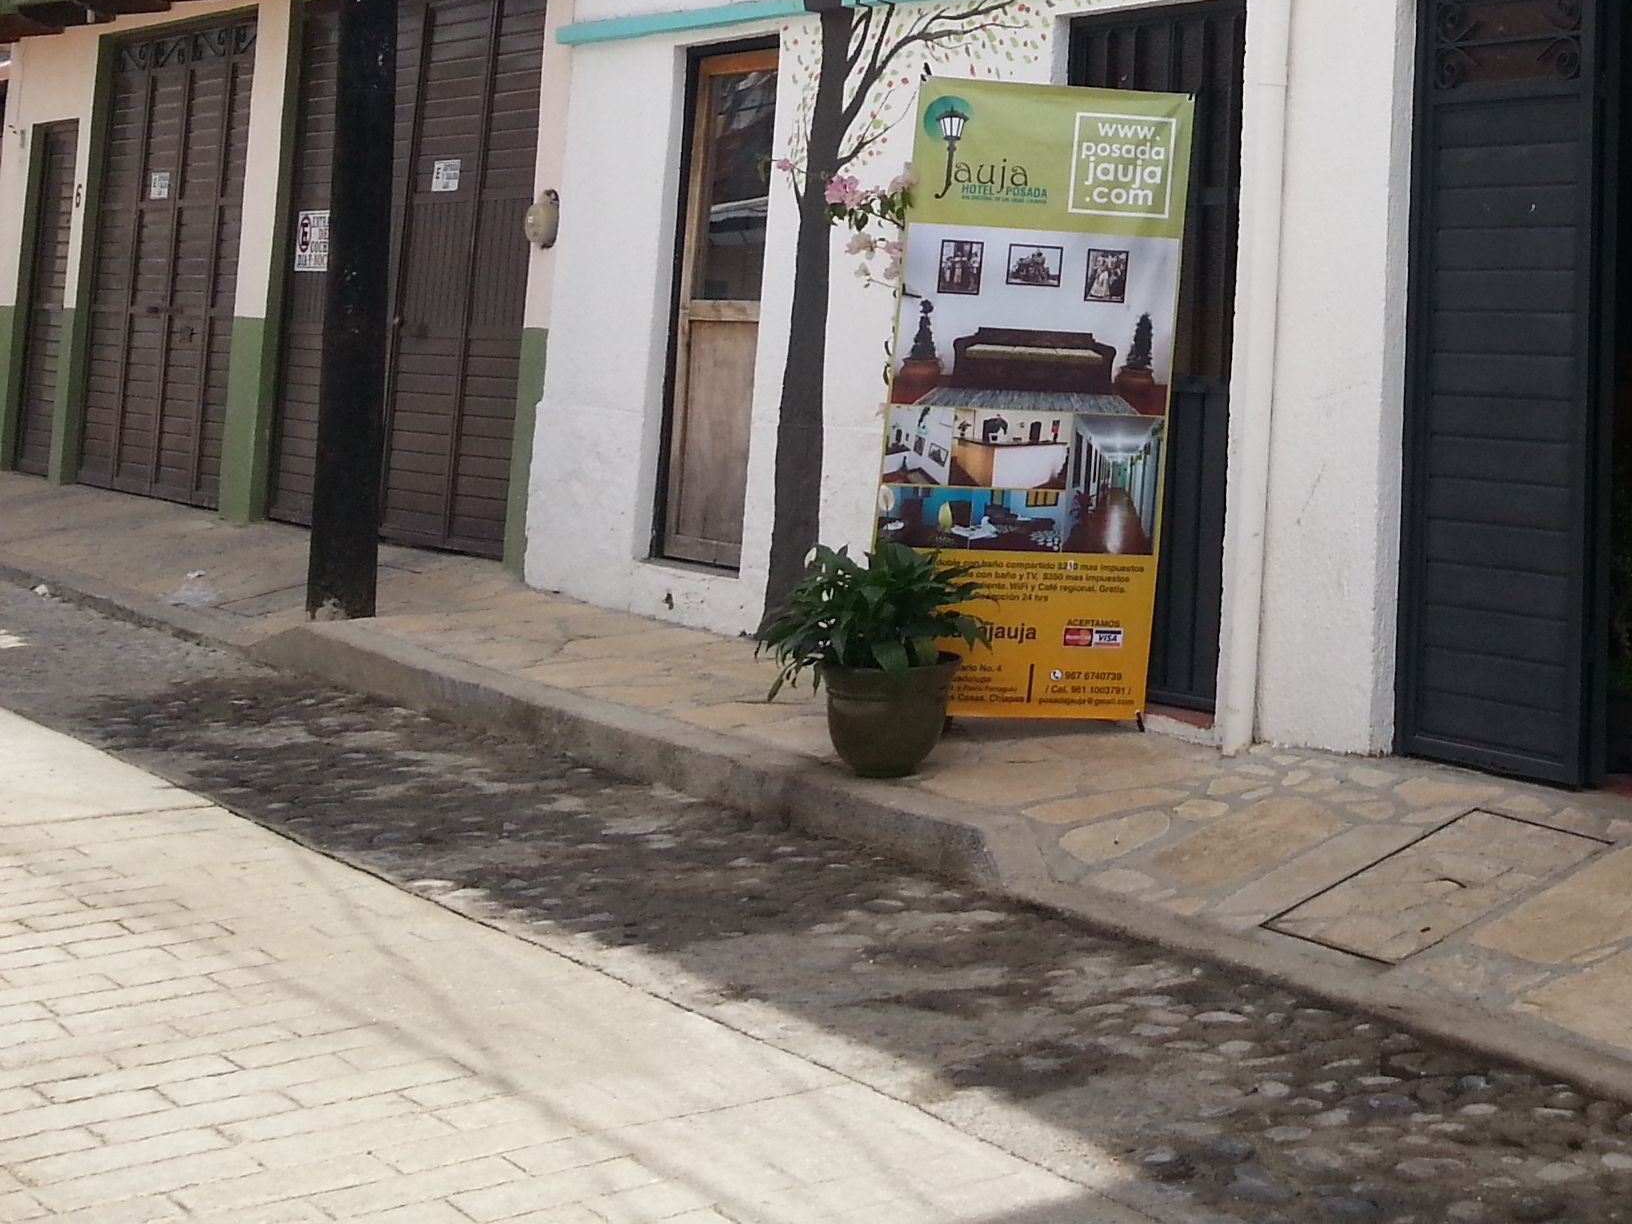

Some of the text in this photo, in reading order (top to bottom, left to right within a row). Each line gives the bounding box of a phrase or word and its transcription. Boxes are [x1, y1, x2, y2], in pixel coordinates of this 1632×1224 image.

[1098, 123, 1160, 141] www.
[1082, 142, 1165, 160] posada
[934, 150, 1028, 199] Jauja
[1084, 156, 1162, 188] jauja
[75, 183, 82, 208] 6
[961, 184, 1048, 198] HOTEL POSADA
[1085, 187, 1153, 206] .com
[1006, 560, 1056, 570] compartido
[1101, 563, 1145, 573] impuestos
[995, 571, 1017, 579] baño
[1086, 573, 1130, 583] impuestos
[1038, 583, 1058, 591] Café
[1022, 593, 1032, 601] 24
[1066, 618, 1121, 628] ACEPTAMOS
[1098, 634, 1118, 642] VISA
